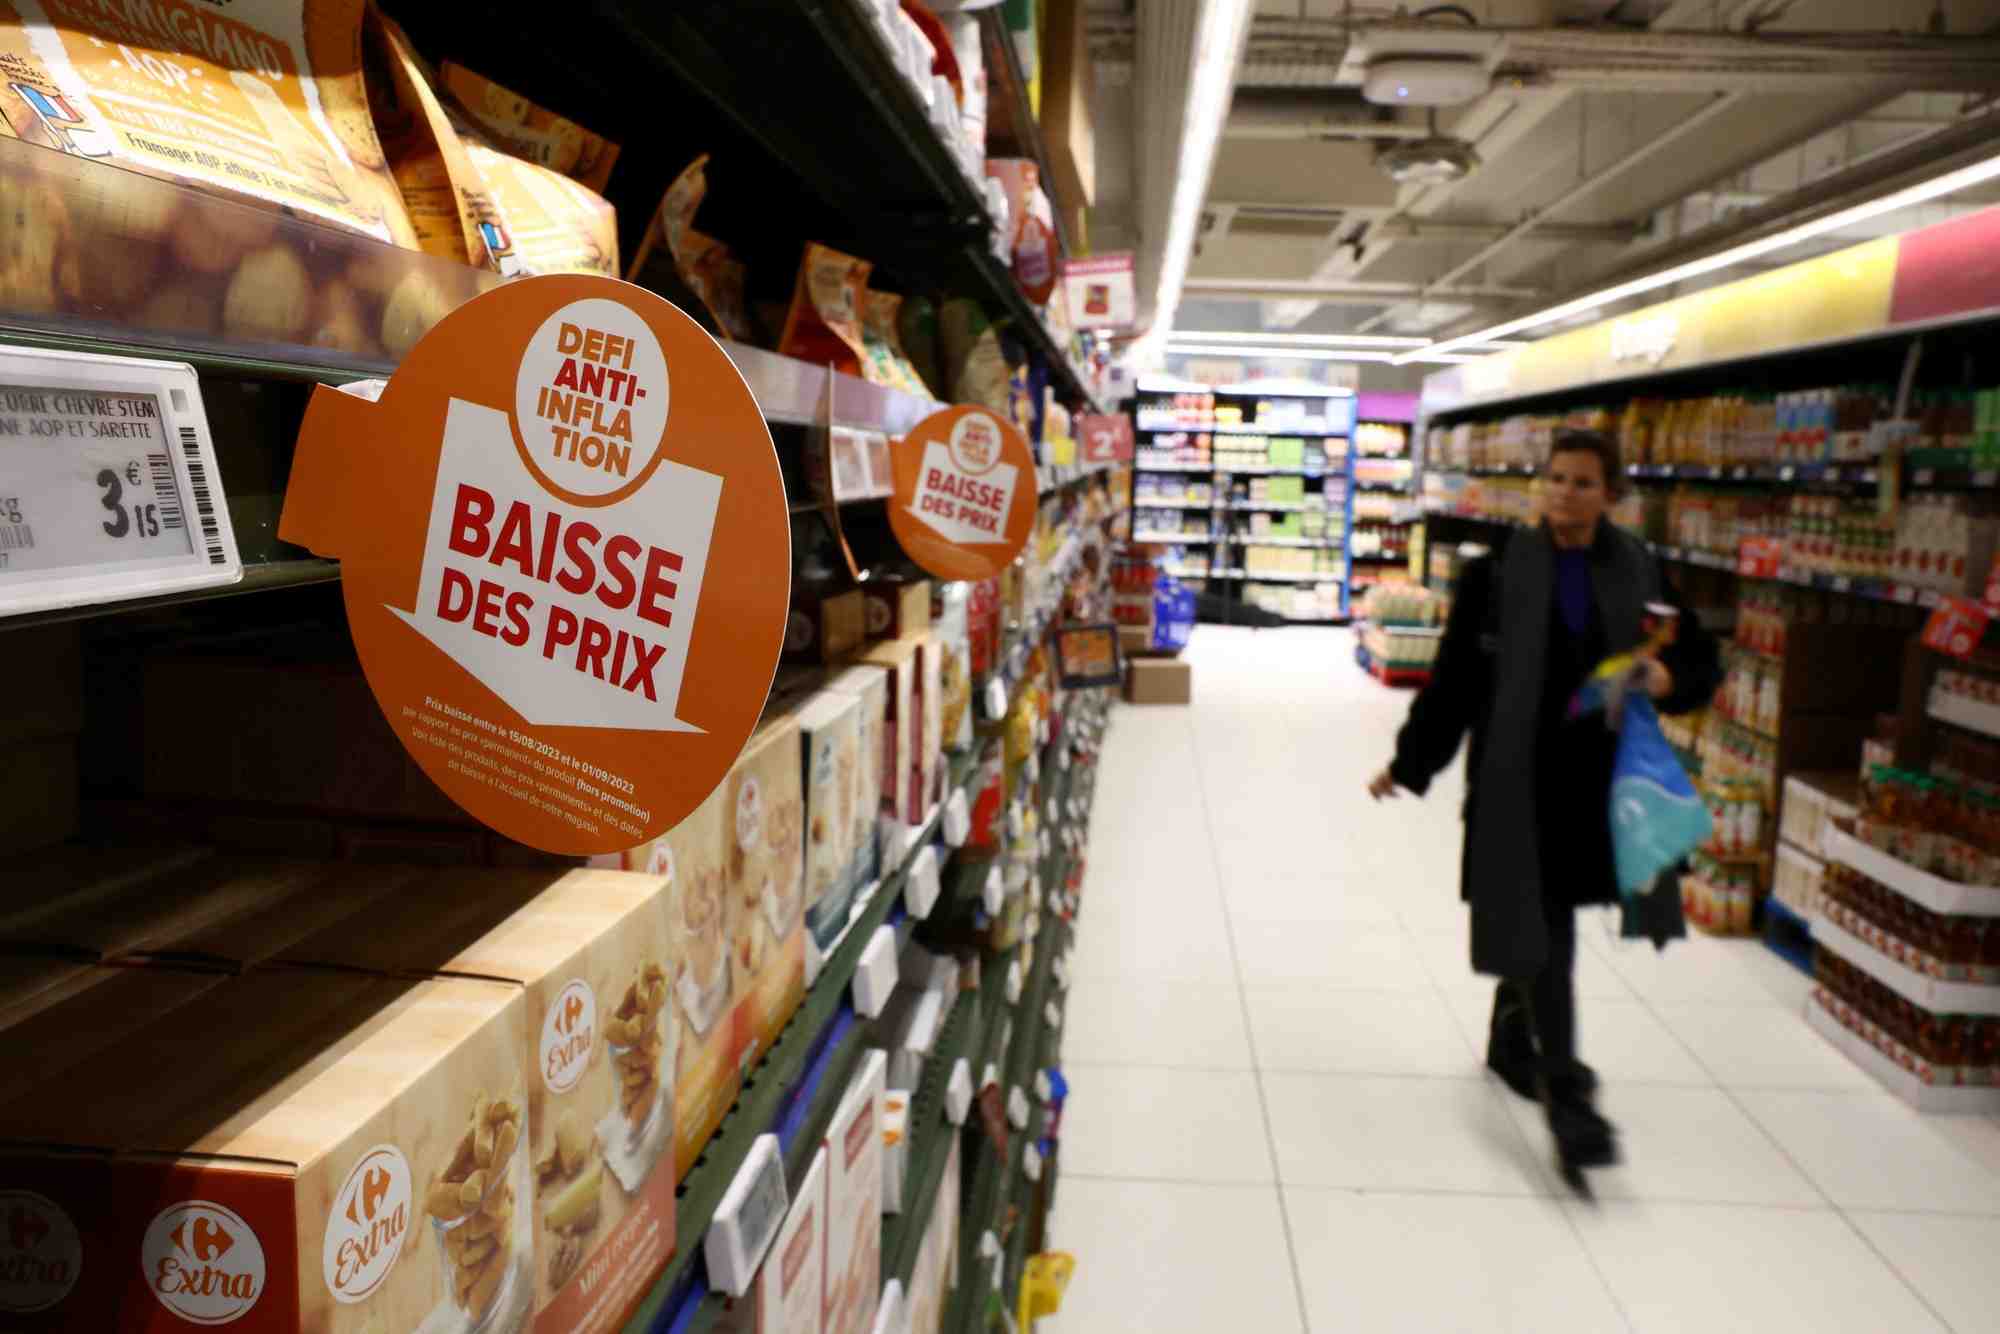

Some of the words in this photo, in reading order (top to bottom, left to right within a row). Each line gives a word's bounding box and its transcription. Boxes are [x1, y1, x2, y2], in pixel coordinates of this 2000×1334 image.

[117, 44, 190, 93] AOP
[125, 132, 193, 163] Fromage
[557, 322, 636, 369] DEFI
[54, 394, 114, 416] CHEVRE
[553, 358, 647, 407] ANTI-
[30, 418, 64, 437] AOP
[67, 420, 86, 437] ET
[536, 386, 633, 444] INFLA
[551, 424, 631, 477] TION
[920, 494, 955, 518] DES
[958, 505, 999, 534] PRIX
[926, 468, 1005, 512] BAISSE
[449, 483, 684, 628] BAISSE
[437, 566, 534, 648] DES
[543, 605, 667, 703] PRIX
[508, 729, 560, 760] 15/08/2023
[561, 754, 571, 767] et
[571, 758, 581, 770] le
[581, 762, 635, 795] 01/09/2023
[545, 765, 576, 785] produit
[576, 778, 600, 798] (hors
[600, 790, 651, 825] promotion)
[620, 820, 643, 839] dates
[546, 1024, 592, 1080] Extra
[333, 1200, 406, 1289] Extra
[155, 1255, 257, 1299] Extra
